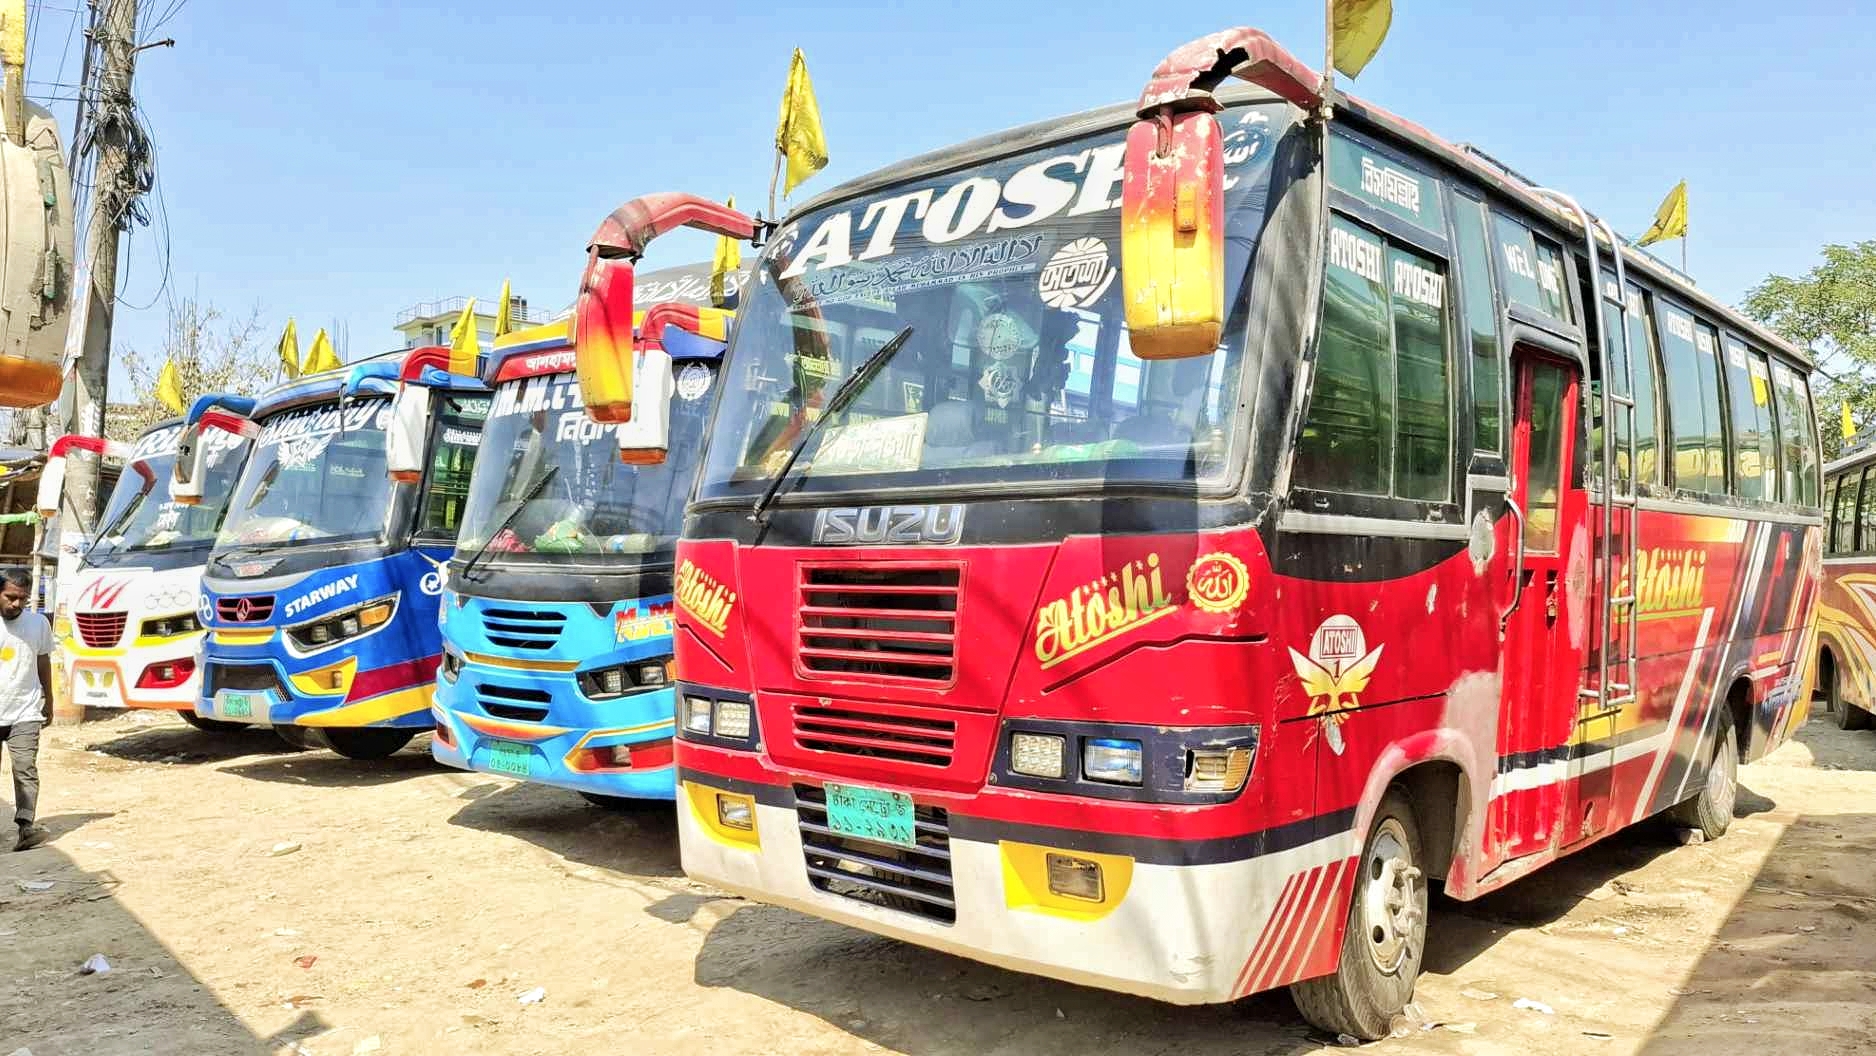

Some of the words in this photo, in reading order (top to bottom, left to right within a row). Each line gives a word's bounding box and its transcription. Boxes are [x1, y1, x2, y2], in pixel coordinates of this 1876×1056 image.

[1329, 228, 1381, 284] ATOSHI
[1394, 259, 1443, 309] ATOSHI
[812, 503, 967, 546] ISUZU
[284, 574, 359, 618] STARWAY
[675, 558, 738, 632] Atoshi
[1035, 552, 1172, 663] Atoshi
[1323, 629, 1357, 655] ATOSHI
[1333, 659, 1341, 679] 1
